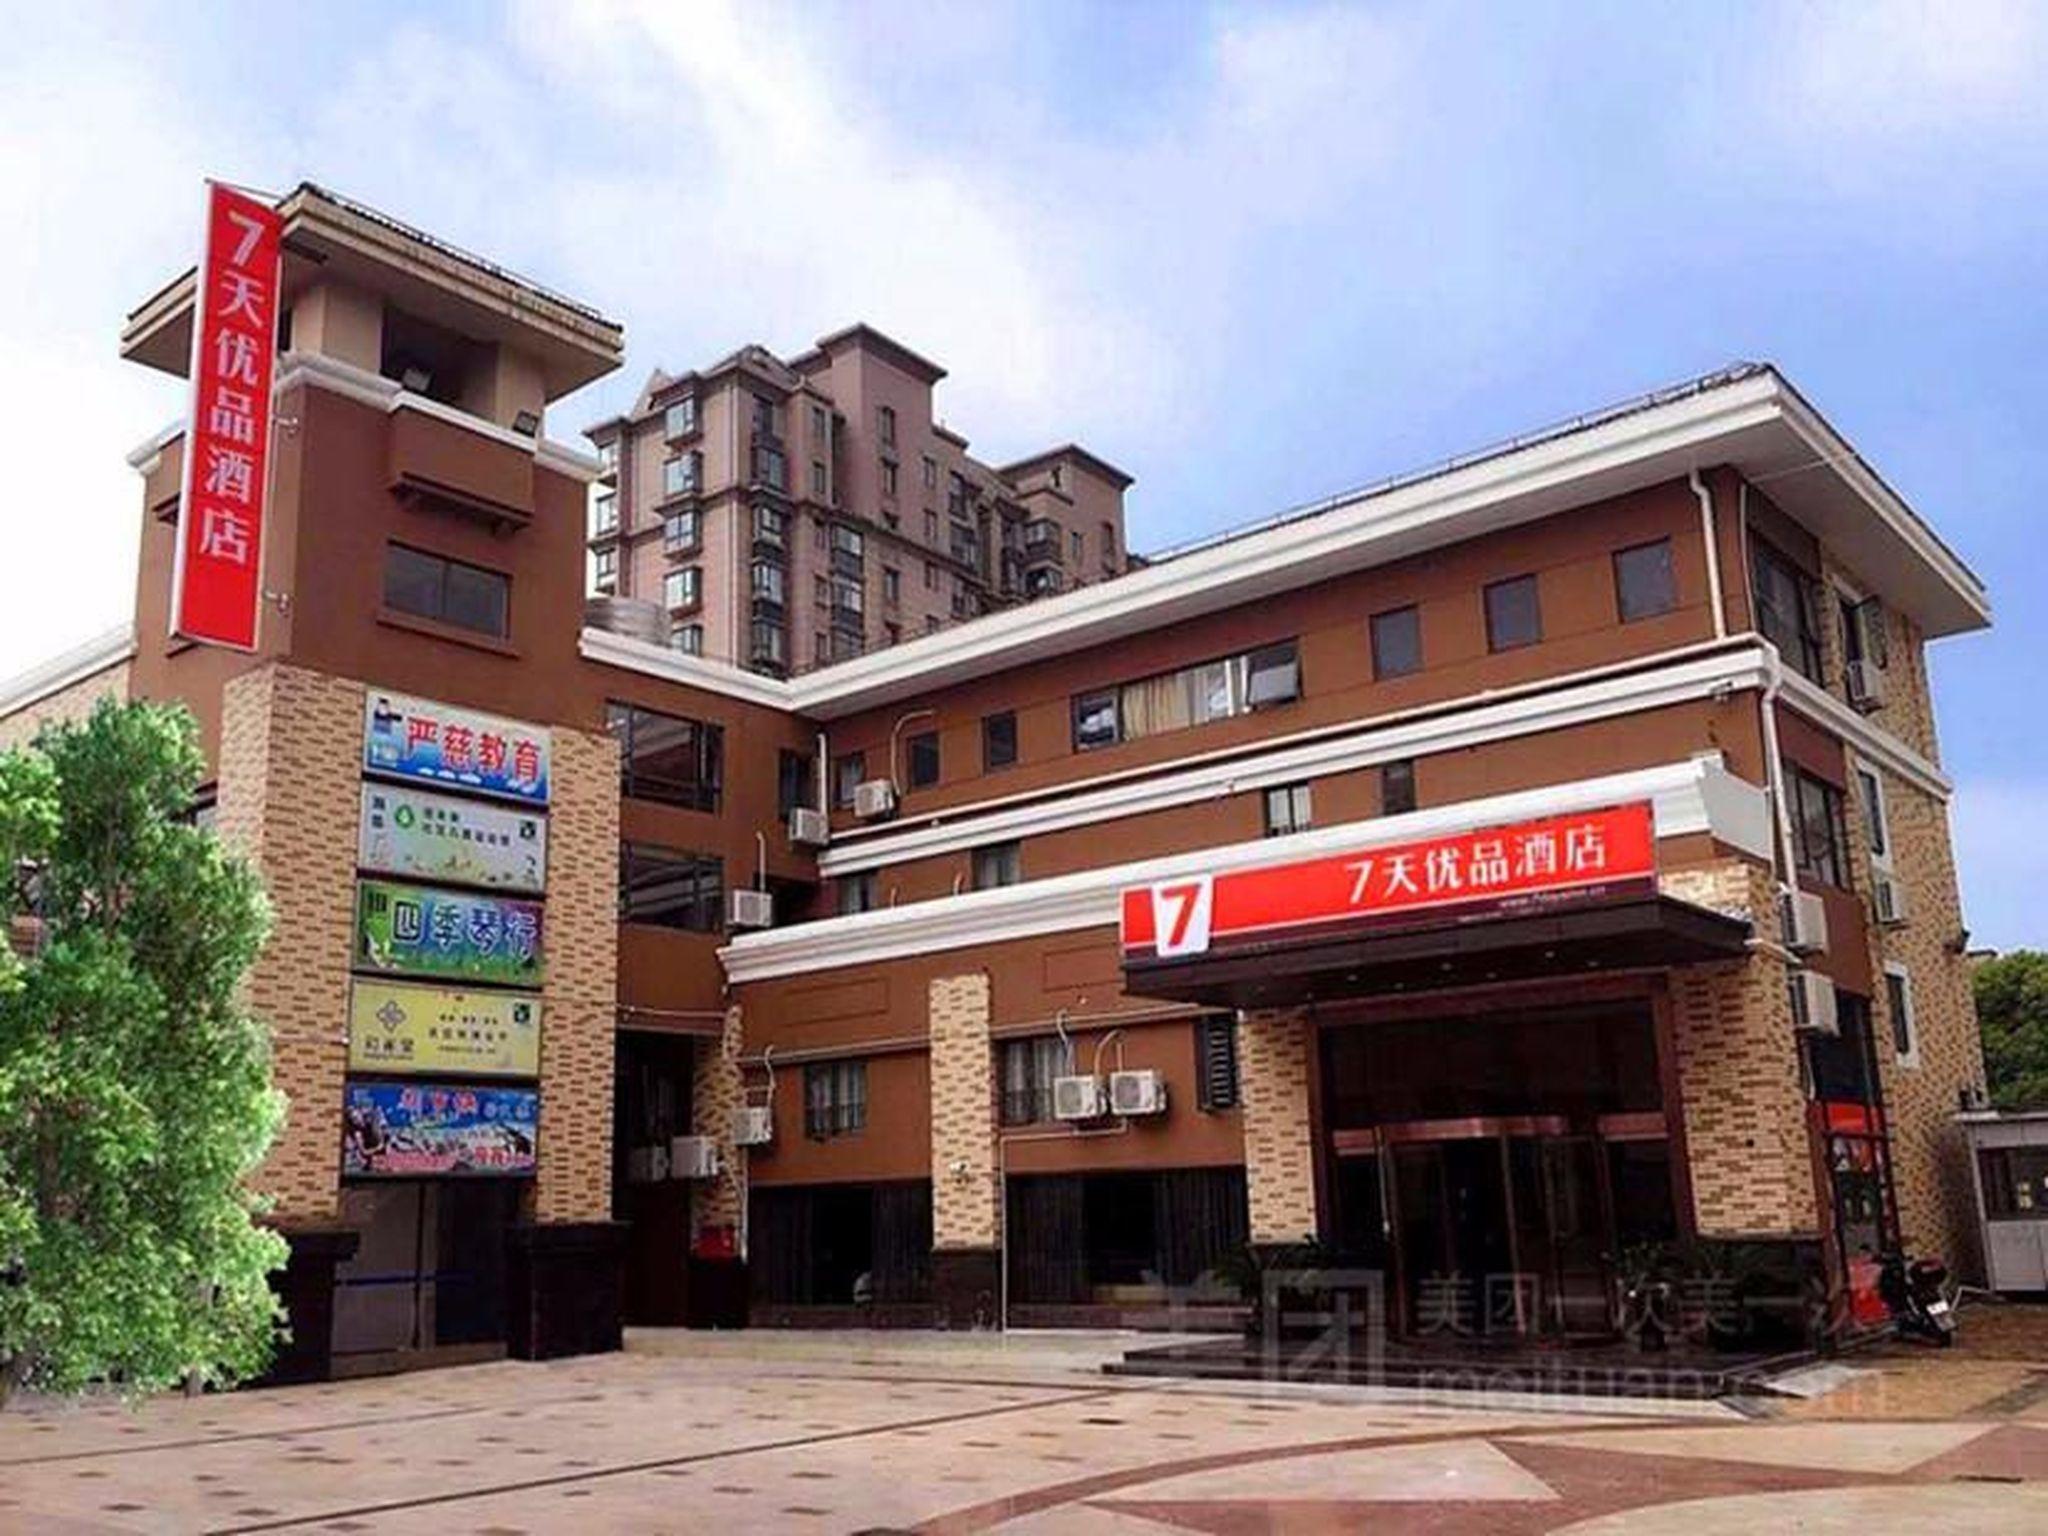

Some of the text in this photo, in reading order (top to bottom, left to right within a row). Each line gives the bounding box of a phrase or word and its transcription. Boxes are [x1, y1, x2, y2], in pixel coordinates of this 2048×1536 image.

[199, 210, 266, 566] 7天优品酒店
[405, 714, 541, 788] 严慈教育
[1346, 823, 1606, 904] 7天优品酒店
[1160, 883, 1203, 948] 7
